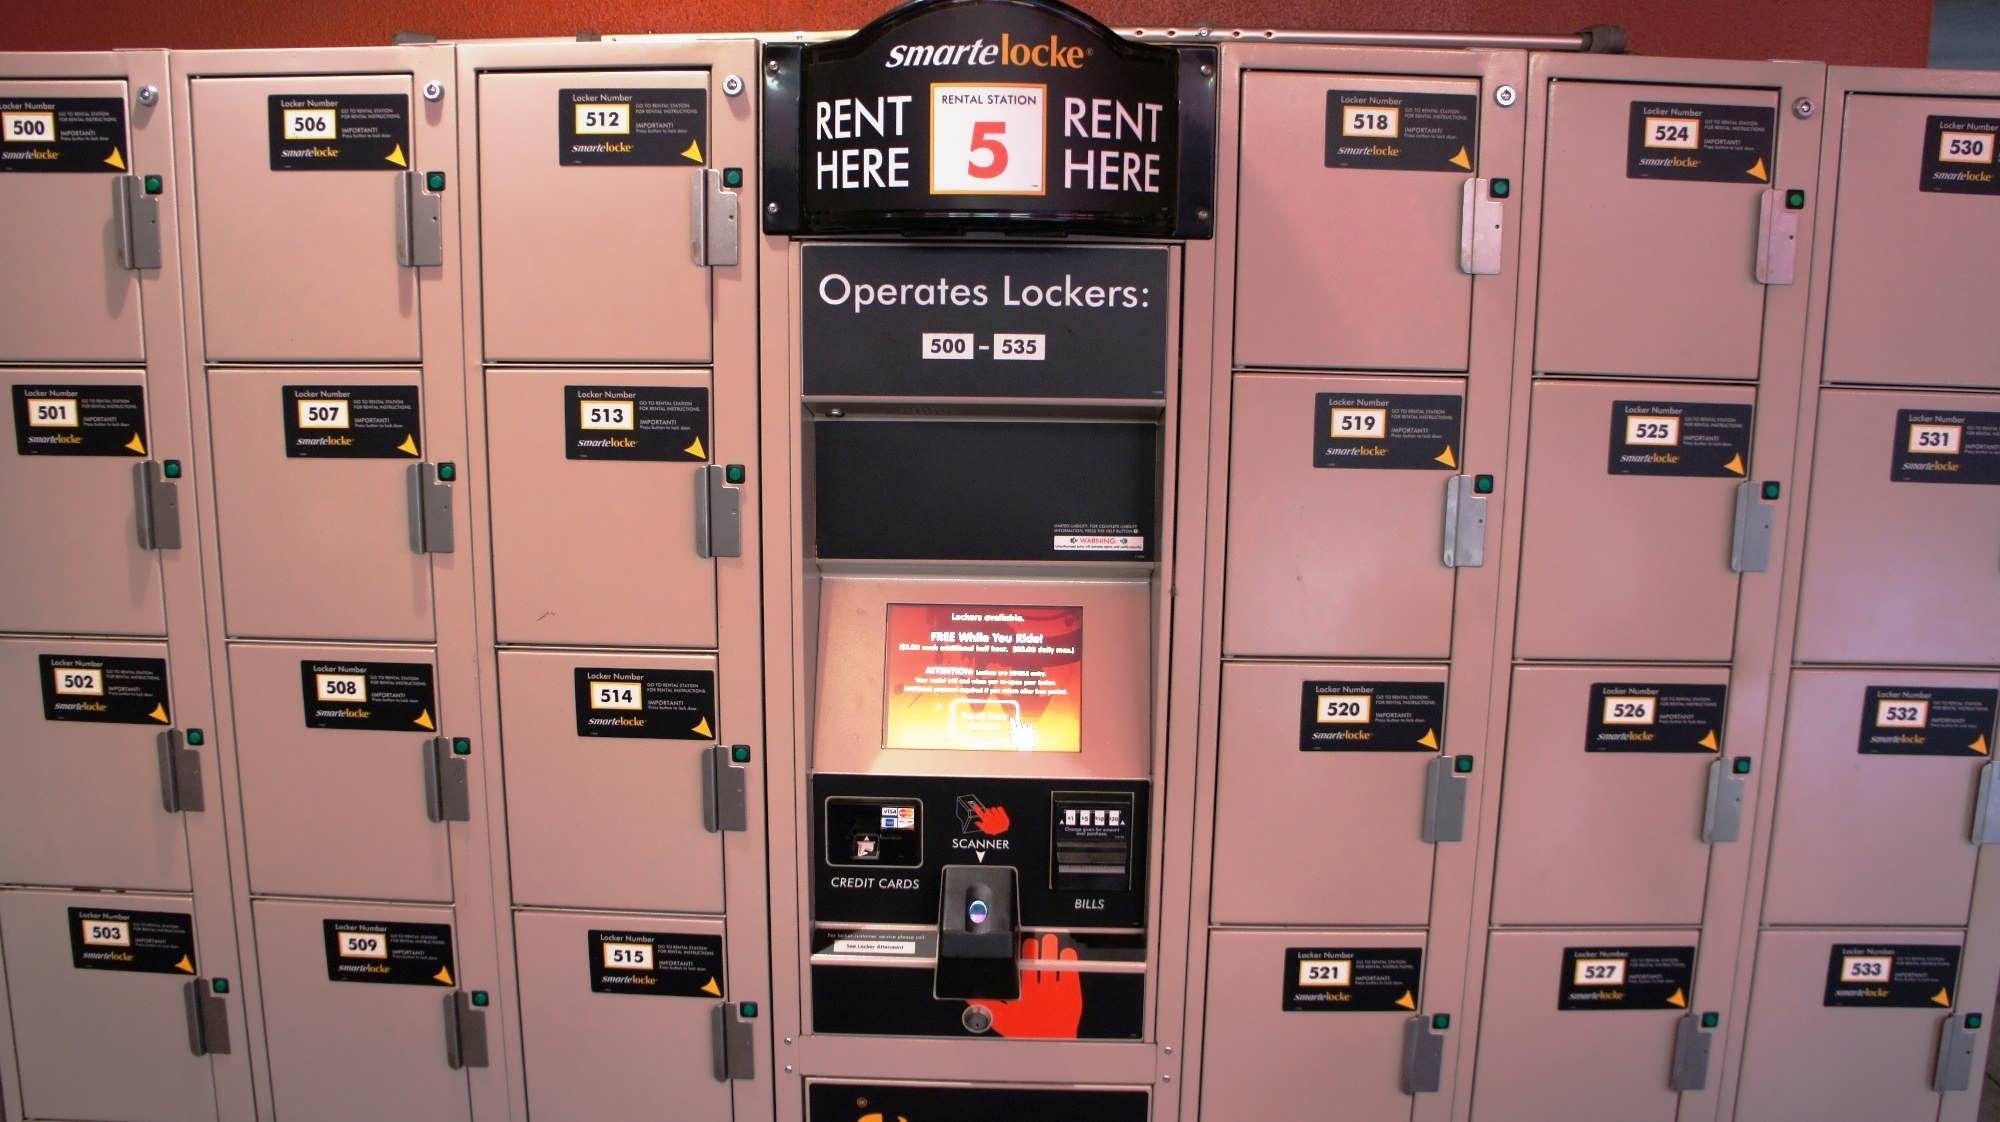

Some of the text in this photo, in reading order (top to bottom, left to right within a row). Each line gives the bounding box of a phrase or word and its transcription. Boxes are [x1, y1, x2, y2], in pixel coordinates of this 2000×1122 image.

[307, 99, 338, 107] Number
[573, 94, 598, 102] Locker
[941, 94, 1037, 106] RENTAL STATION
[1341, 96, 1402, 105] Locker Number
[25, 102, 55, 110] Number
[1644, 107, 1702, 117] Locker Number
[295, 117, 326, 131] 506
[587, 112, 618, 126] 512
[817, 95, 912, 140] RENT
[1064, 97, 1163, 142] RENT
[1354, 114, 1387, 130] 518
[14, 121, 45, 135] 500
[1940, 121, 1999, 132] Locker Number
[1656, 126, 1688, 141] 524
[967, 121, 1009, 179] 5
[1950, 140, 1983, 155] 530
[817, 148, 910, 190] HERE
[1064, 149, 1160, 193] HERE
[819, 273, 1149, 314] Operates Lockers:
[930, 338, 966, 354] 500
[1001, 339, 1037, 355] 535
[39, 406, 65, 419] 501
[309, 407, 338, 421] 507
[592, 409, 623, 423] 513
[1342, 416, 1375, 430] 519
[1637, 424, 1668, 438] 525
[1919, 432, 1948, 446] 531
[930, 632, 956, 642] FREE
[959, 632, 990, 642] While
[992, 633, 1012, 644] You
[74, 660, 103, 669] Number
[65, 675, 93, 688] 502
[327, 681, 356, 694] 508
[601, 689, 632, 703] 514
[1328, 702, 1360, 716] 520
[1614, 704, 1645, 717] 526
[1887, 707, 1917, 721] 532
[952, 838, 1010, 850] SCANNER
[831, 876, 920, 890] CREDIT CARDS
[1074, 899, 1104, 910] BILLS
[102, 913, 129, 921] Number
[93, 926, 120, 939] 503
[359, 925, 387, 933] Number
[349, 938, 377, 951] 509
[601, 934, 654, 943] Locker Number
[614, 950, 643, 963] 515
[1309, 967, 1338, 979] 521
[1585, 966, 1616, 979] 527
[1852, 963, 1881, 976] 533
